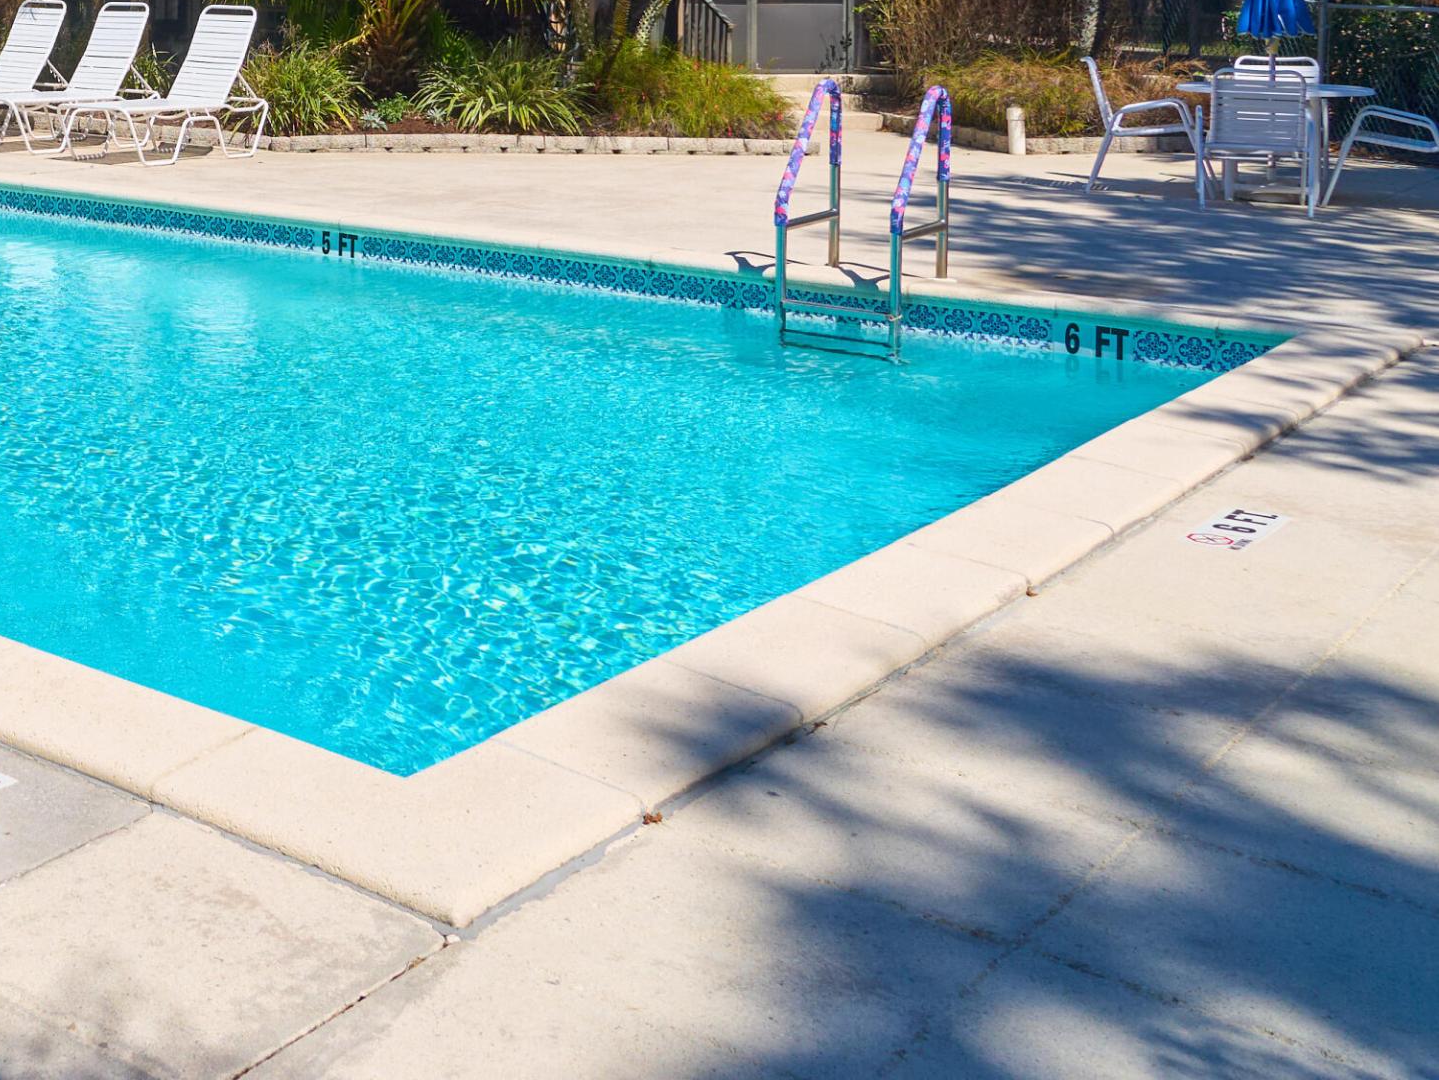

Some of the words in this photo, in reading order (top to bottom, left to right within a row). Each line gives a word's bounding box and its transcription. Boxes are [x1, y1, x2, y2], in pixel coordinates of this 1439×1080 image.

[322, 231, 331, 255] 5
[338, 232, 359, 258] FT
[1064, 322, 1081, 355] 6
[1095, 325, 1130, 361] FT
[1212, 523, 1257, 534] 6
